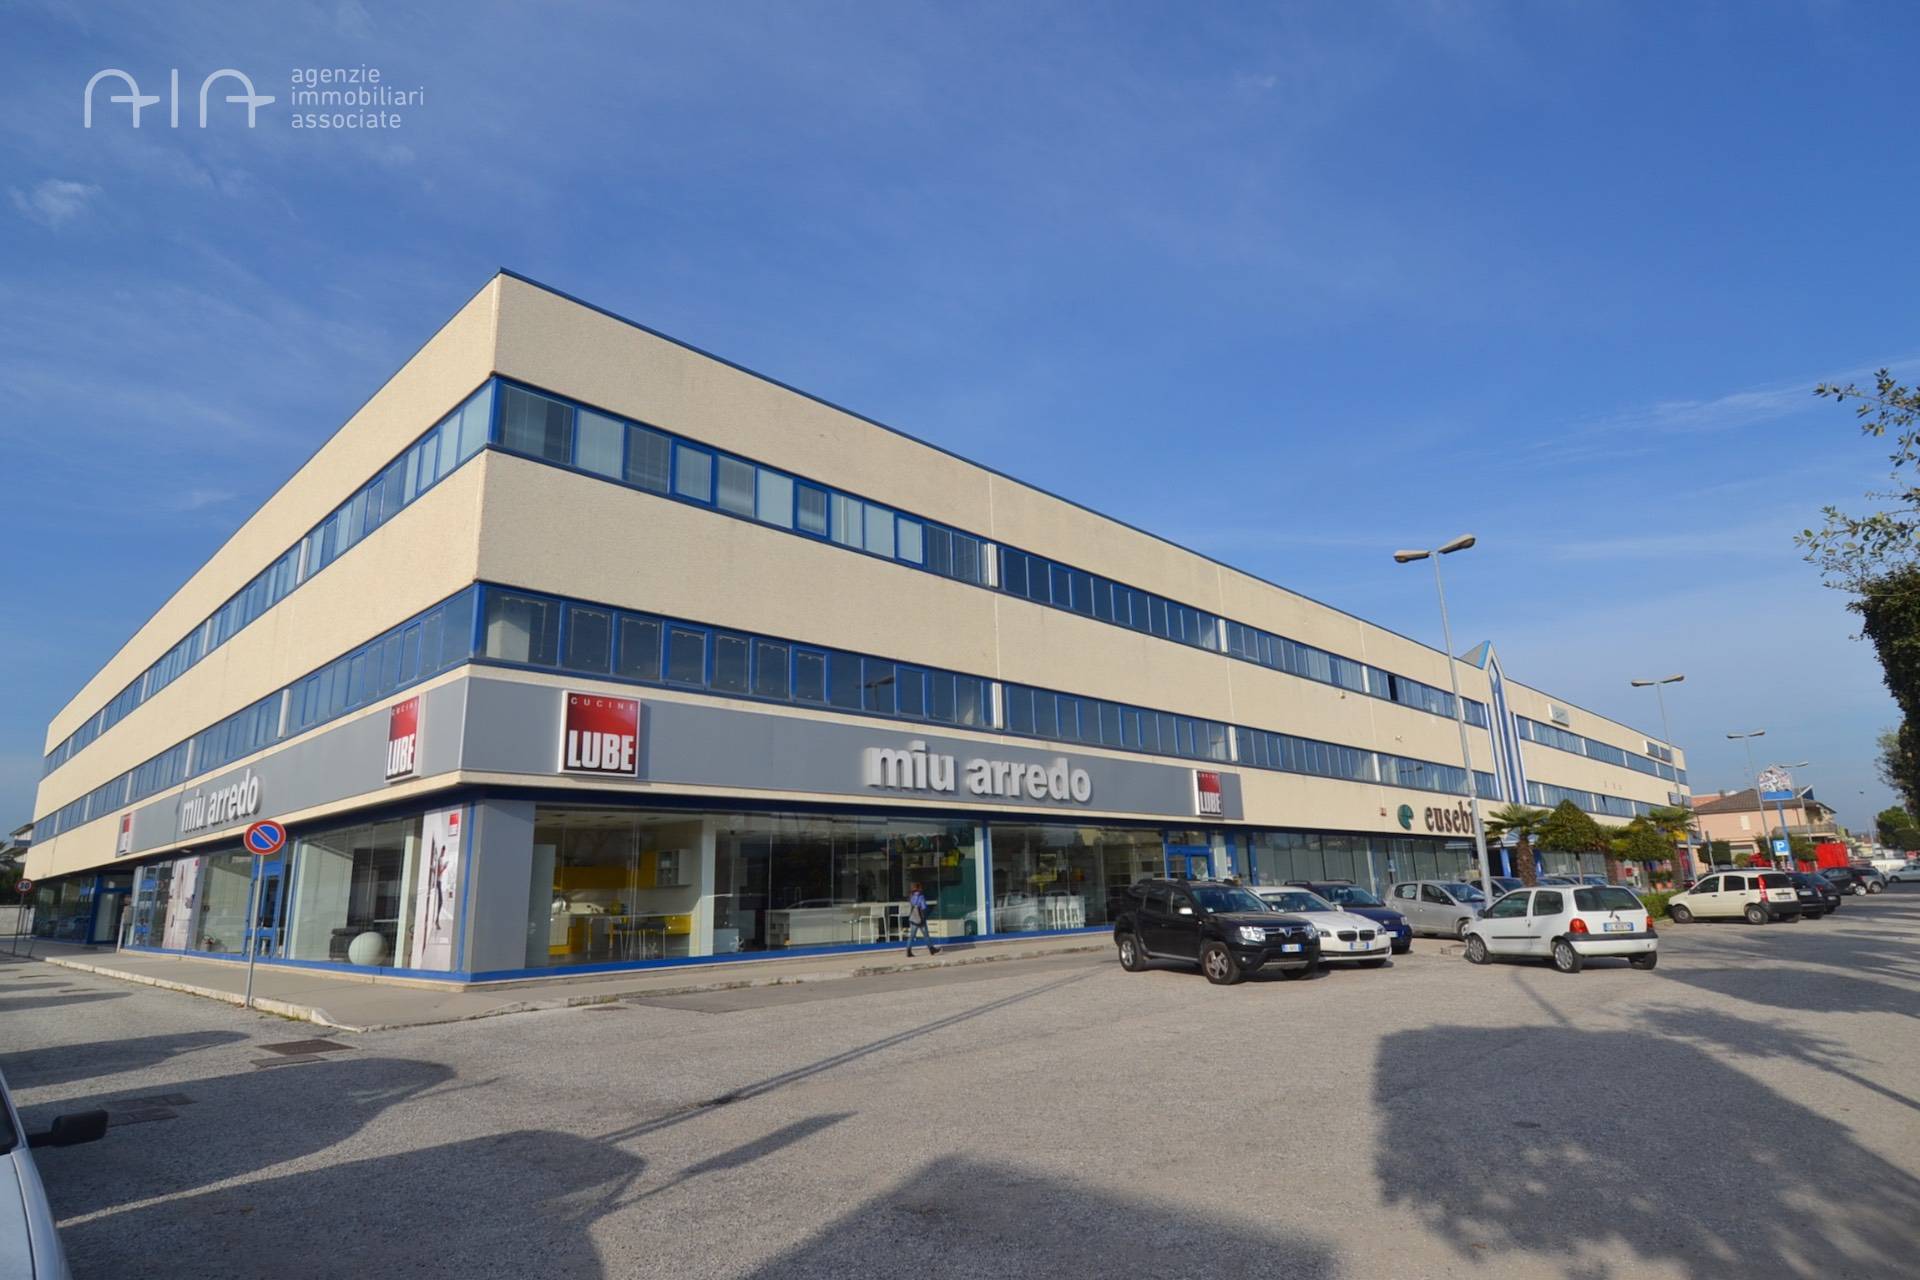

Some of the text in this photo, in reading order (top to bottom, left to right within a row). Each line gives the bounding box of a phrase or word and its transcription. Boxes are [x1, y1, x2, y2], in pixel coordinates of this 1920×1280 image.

[386, 733, 415, 776] LUBE
[567, 730, 634, 771] LUBE
[865, 740, 1092, 802] miu arredo
[181, 768, 258, 832] miu arredo
